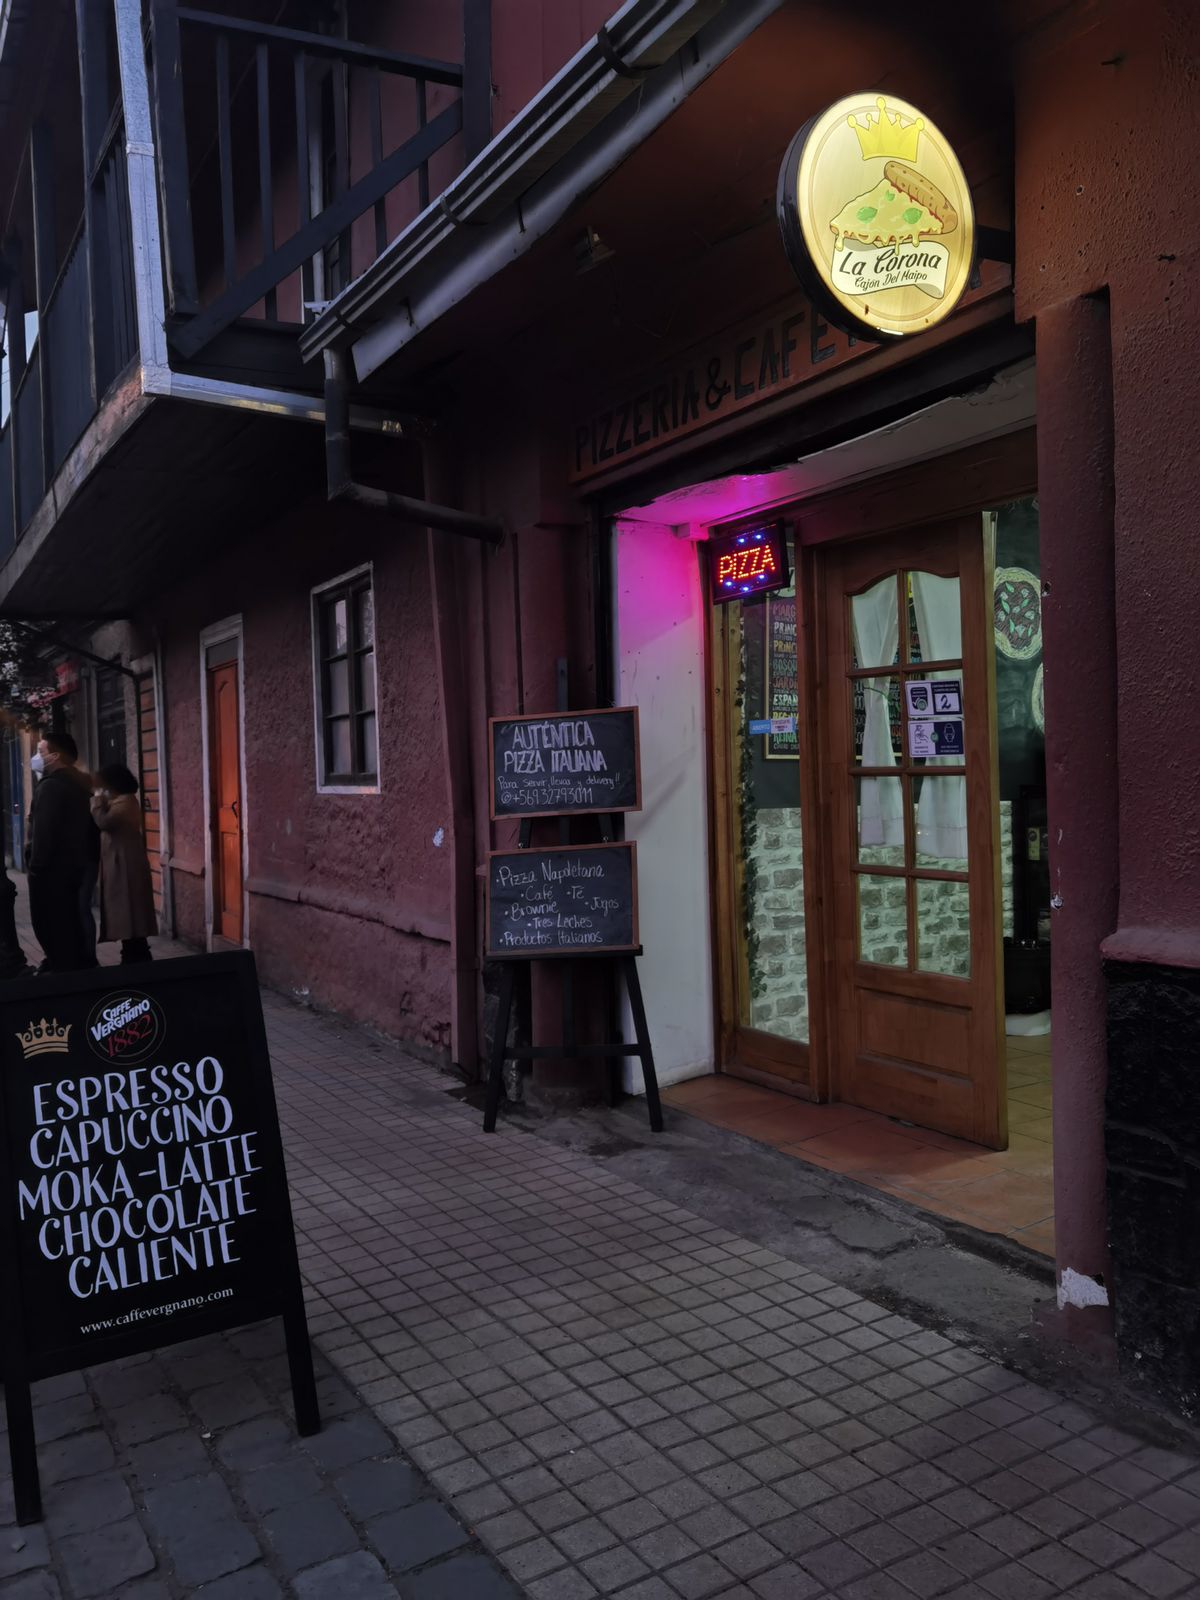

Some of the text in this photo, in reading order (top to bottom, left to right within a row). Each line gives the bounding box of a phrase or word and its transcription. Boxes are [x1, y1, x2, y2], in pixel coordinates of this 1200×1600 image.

[839, 248, 942, 275] La Corona
[883, 271, 900, 286] Del
[901, 269, 927, 283] Maipo
[576, 370, 699, 472] PIZZERIA
[734, 303, 857, 400] CAFE
[719, 544, 776, 583] PIZZA
[939, 694, 952, 710] 2
[504, 750, 607, 774] PIZZA ITALIANA
[497, 776, 518, 790] Para
[499, 859, 605, 887] Pizza Napoletana
[525, 884, 553, 901] Café
[511, 901, 559, 921] Brownie
[532, 913, 592, 929] Tres Leches
[504, 930, 603, 946] Productos Italianos
[91, 999, 151, 1041] VERGNANO
[108, 1013, 153, 1057] 1882
[33, 1055, 224, 1126] ESPRESSO
[30, 1095, 233, 1169] CAPUCCINO
[38, 1174, 257, 1260] CHOCOLATE
[68, 1221, 241, 1299] CALIENTE
[80, 1286, 234, 1334] www.caffevergnano.com
